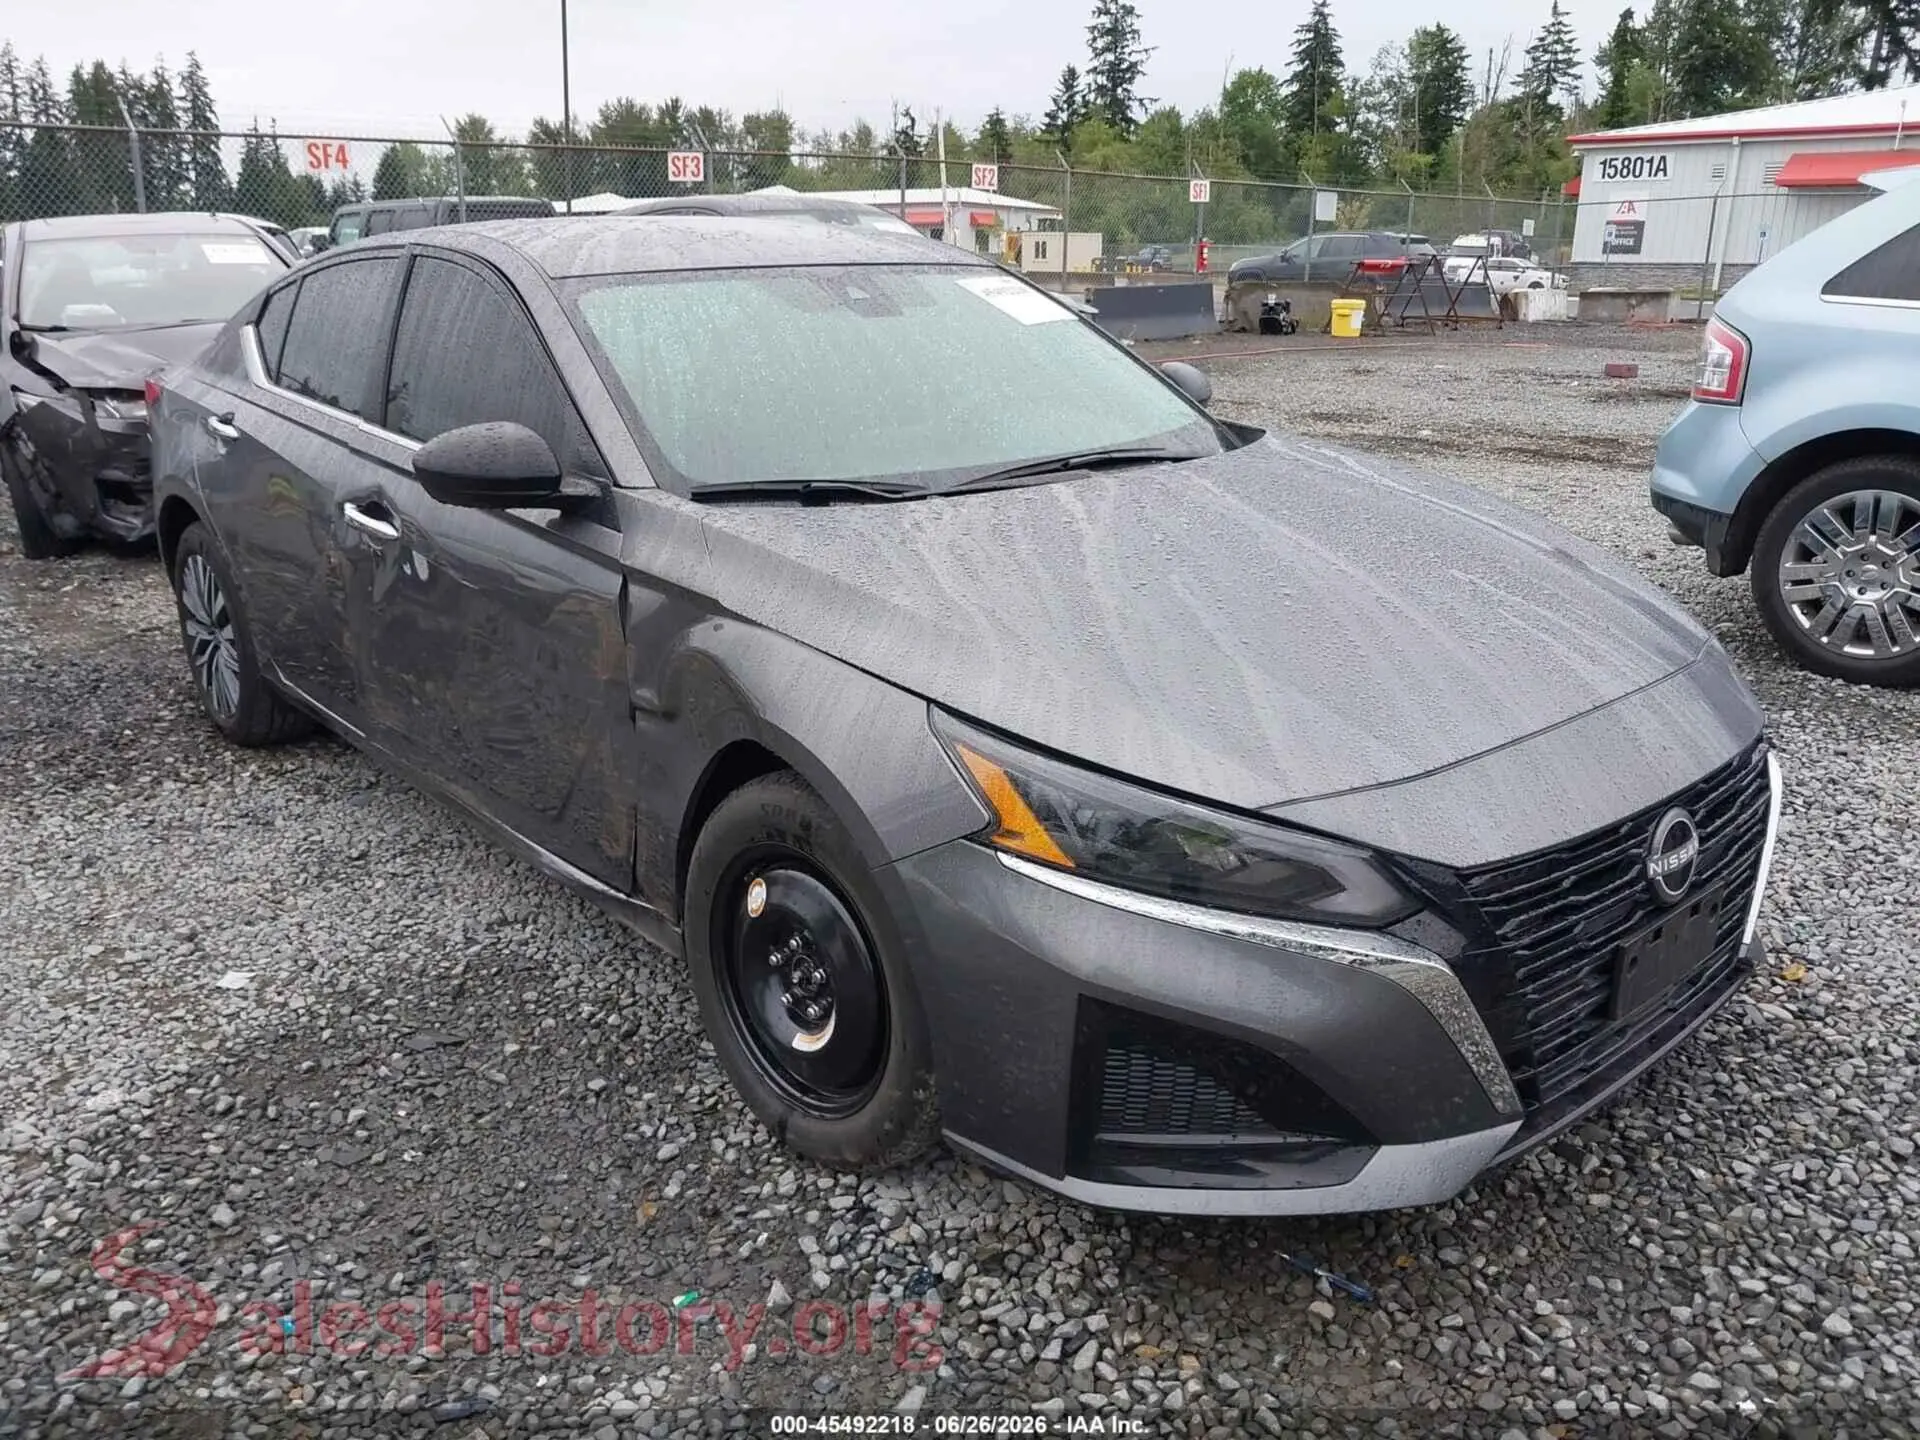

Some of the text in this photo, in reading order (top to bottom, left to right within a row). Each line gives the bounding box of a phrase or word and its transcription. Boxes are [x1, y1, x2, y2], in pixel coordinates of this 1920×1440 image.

[307, 142, 349, 169] SF4
[671, 155, 701, 178] SF3
[1599, 155, 1668, 180] 15801A
[974, 167, 996, 187] SF2
[1192, 182, 1208, 201] SF1
[1648, 840, 1698, 876] NISSA
